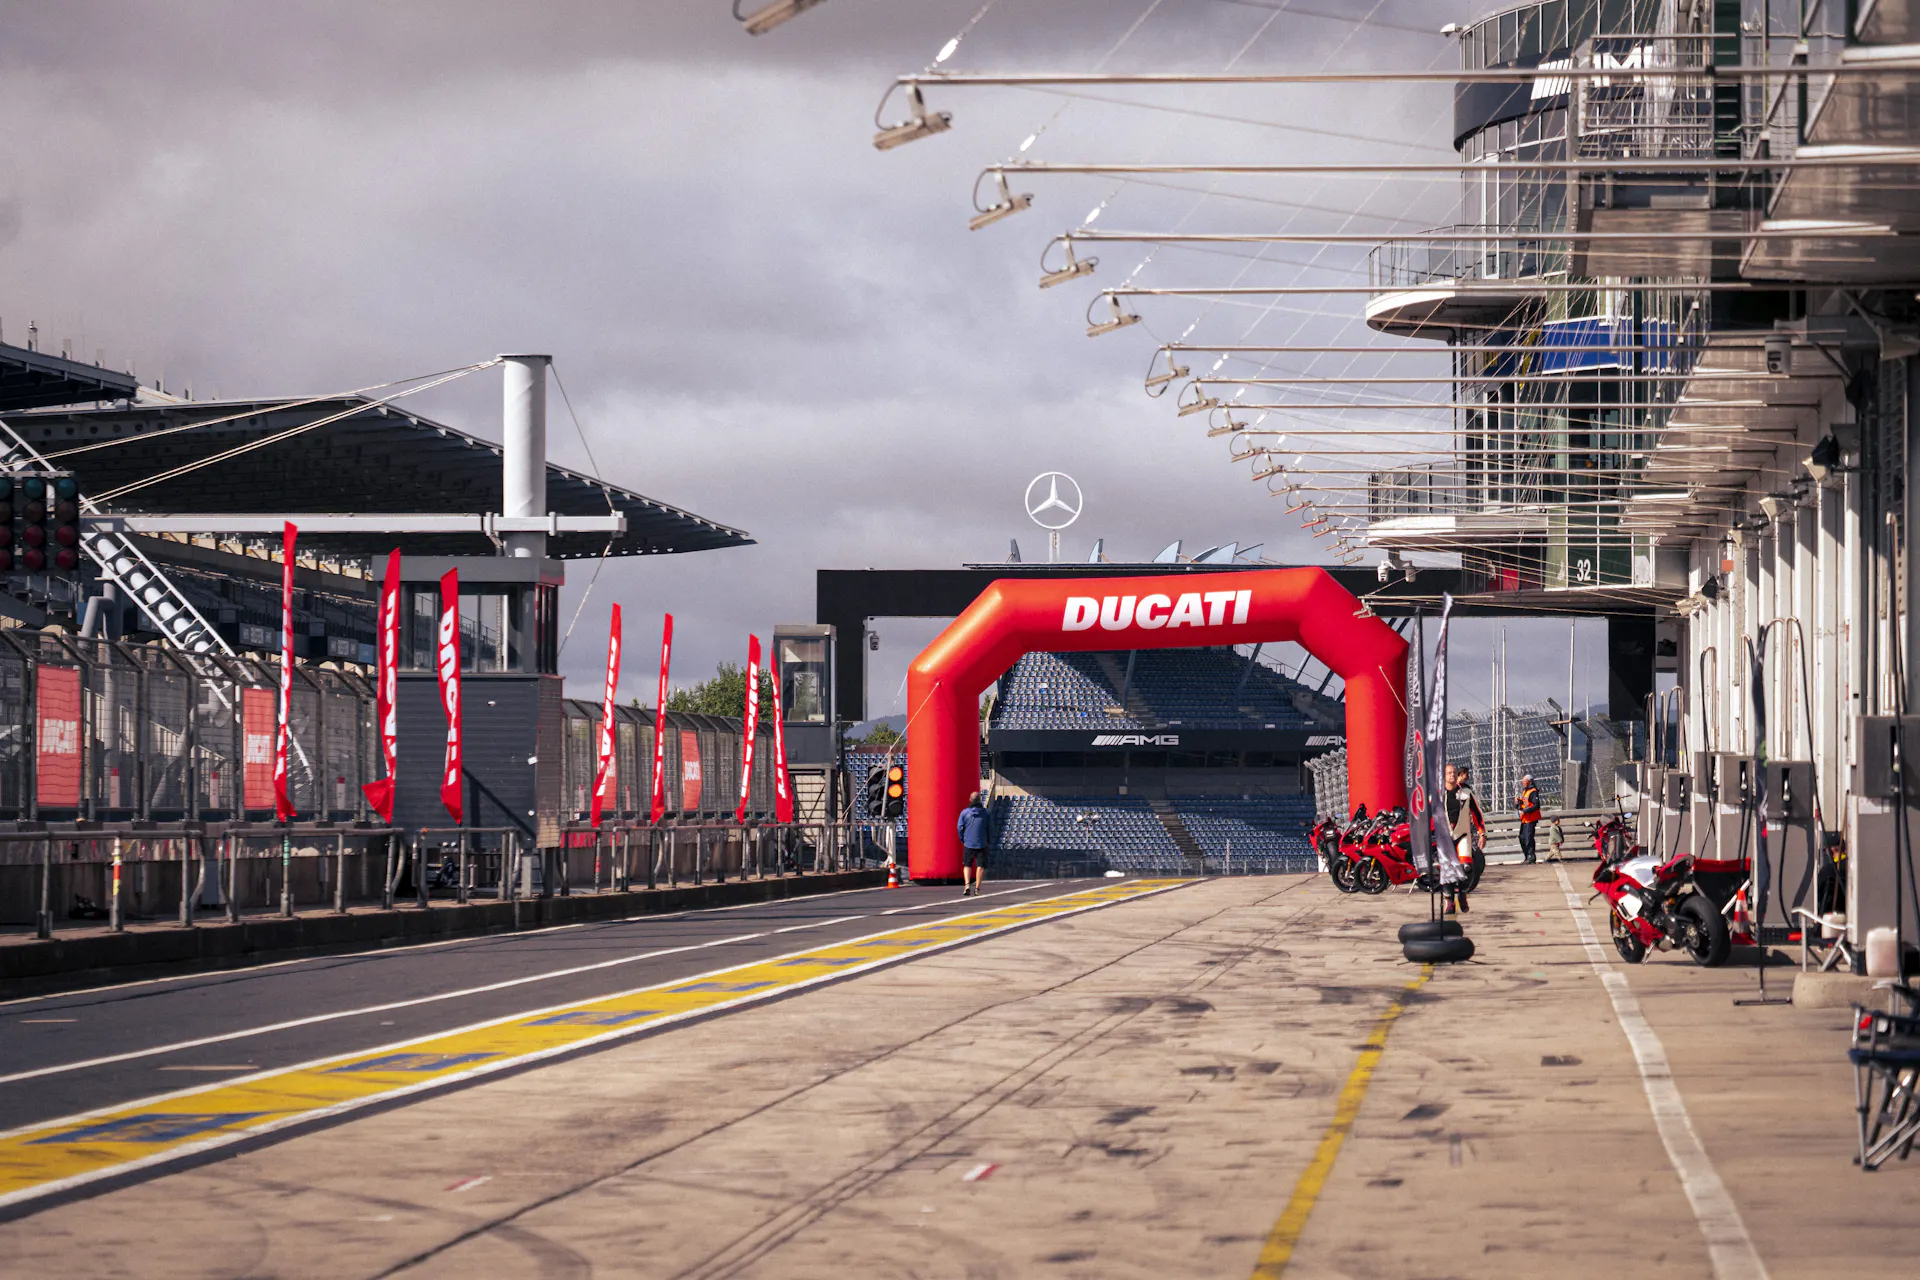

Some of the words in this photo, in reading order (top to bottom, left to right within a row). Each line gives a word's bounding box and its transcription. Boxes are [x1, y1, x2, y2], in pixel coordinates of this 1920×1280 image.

[1577, 559, 1591, 581] 32
[1062, 590, 1252, 631] DUCATI
[1118, 735, 1179, 745] AMG
